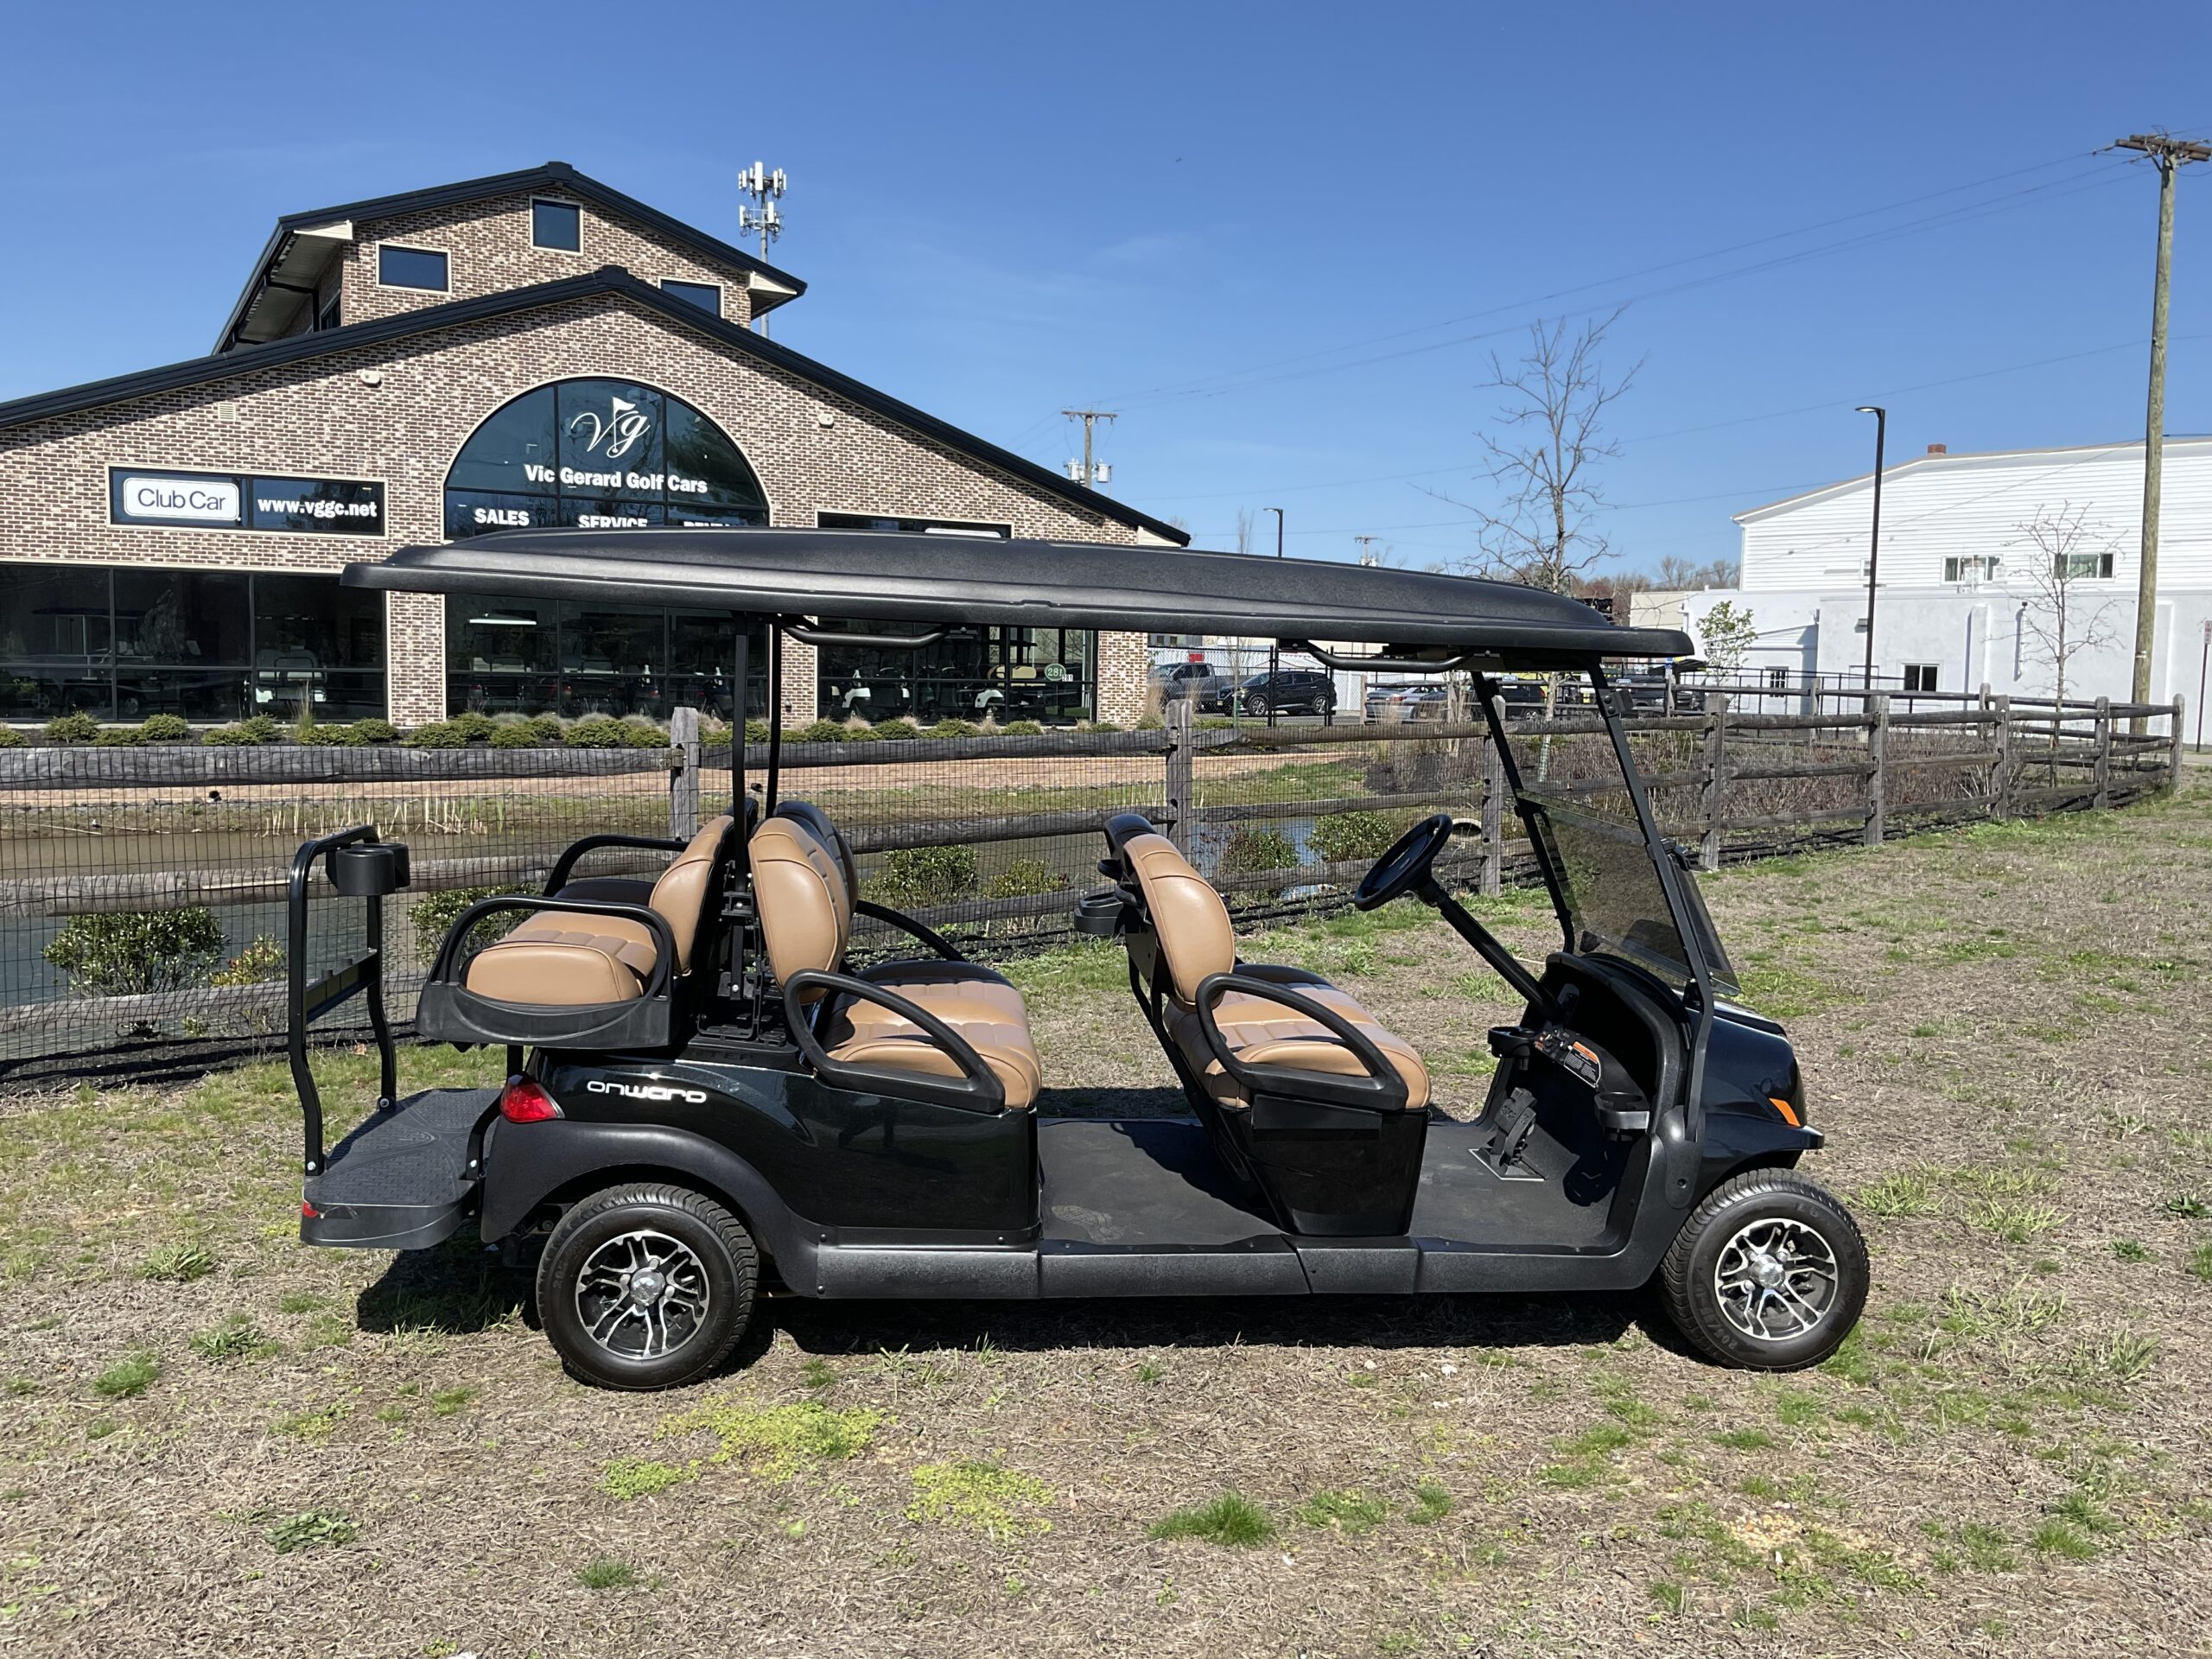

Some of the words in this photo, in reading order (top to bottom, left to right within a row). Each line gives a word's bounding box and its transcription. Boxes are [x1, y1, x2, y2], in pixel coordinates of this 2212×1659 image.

[524, 464, 556, 483] Vic
[560, 467, 622, 488] Gerard
[626, 472, 664, 491] Golf
[667, 474, 709, 493] Cars
[137, 487, 186, 509] Club
[189, 490, 226, 511] Car
[257, 498, 378, 518] www.vggc.net
[474, 507, 530, 526] SALES
[1047, 667, 1063, 677] 281
